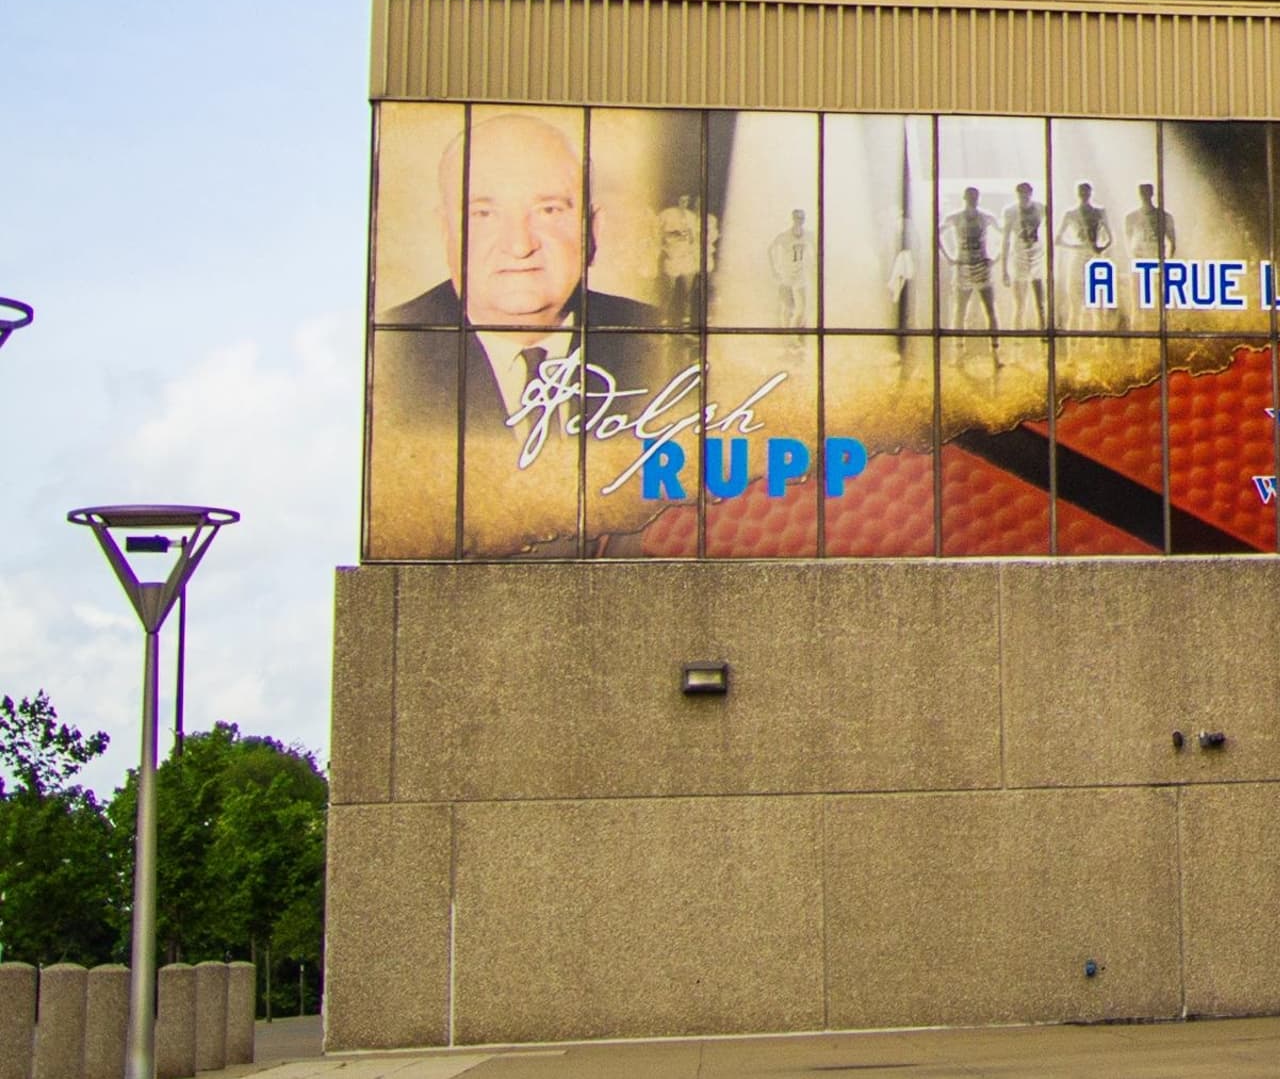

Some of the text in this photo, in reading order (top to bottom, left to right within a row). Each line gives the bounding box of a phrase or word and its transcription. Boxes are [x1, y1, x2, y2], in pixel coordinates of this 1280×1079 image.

[1085, 258, 1118, 309] A
[1131, 258, 1247, 310] TRUE
[506, 347, 787, 495] Adolph
[641, 436, 868, 501] RUPP
